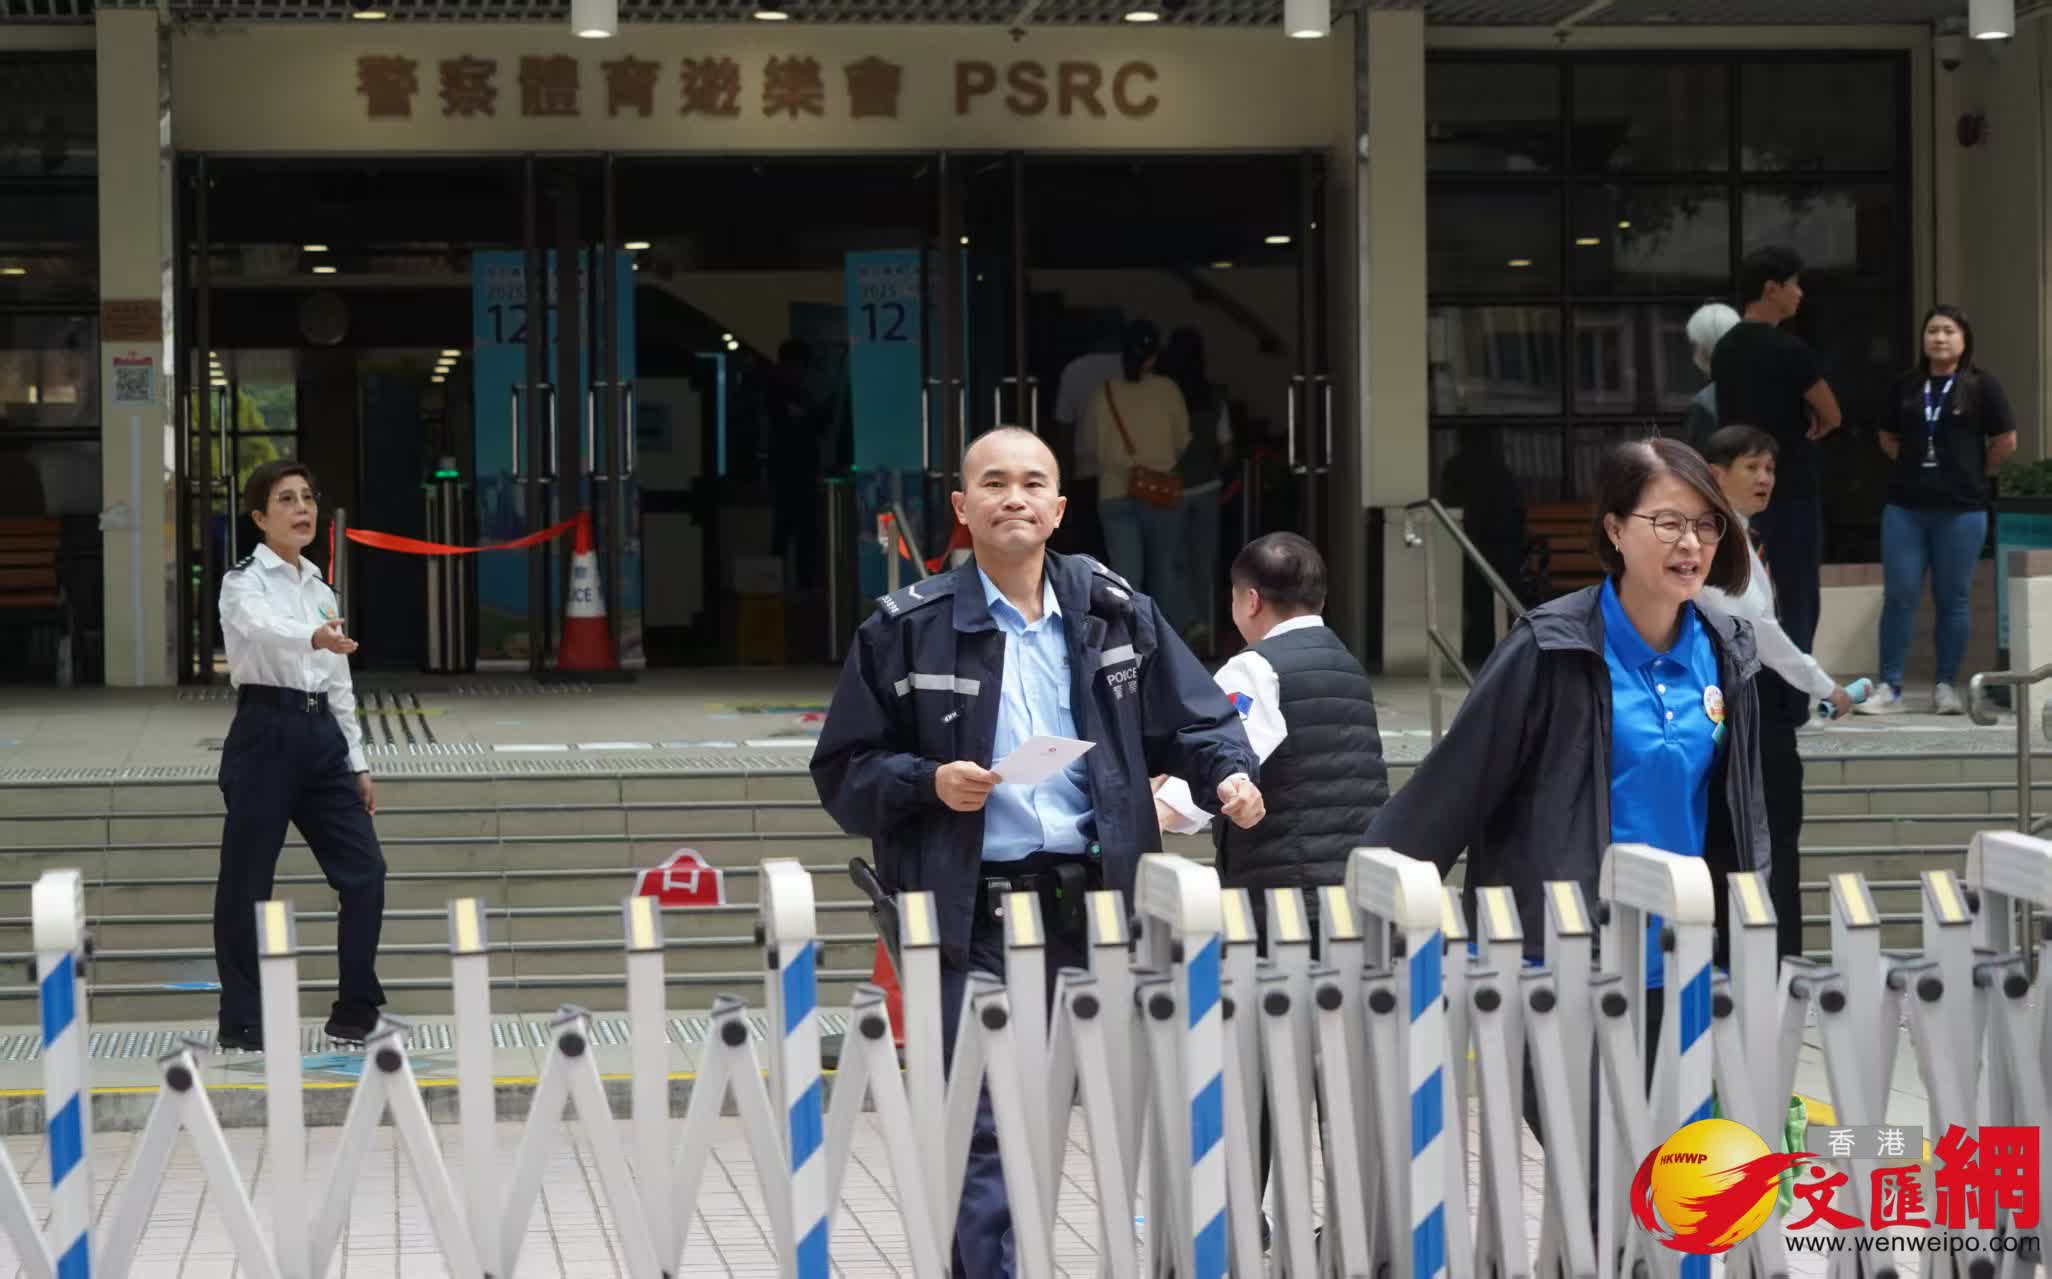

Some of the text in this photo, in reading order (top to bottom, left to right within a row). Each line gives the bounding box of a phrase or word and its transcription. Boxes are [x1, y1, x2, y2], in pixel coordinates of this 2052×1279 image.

[357, 54, 1160, 118] 警察體育遊樂會 PSRC
[860, 302, 908, 343] 12
